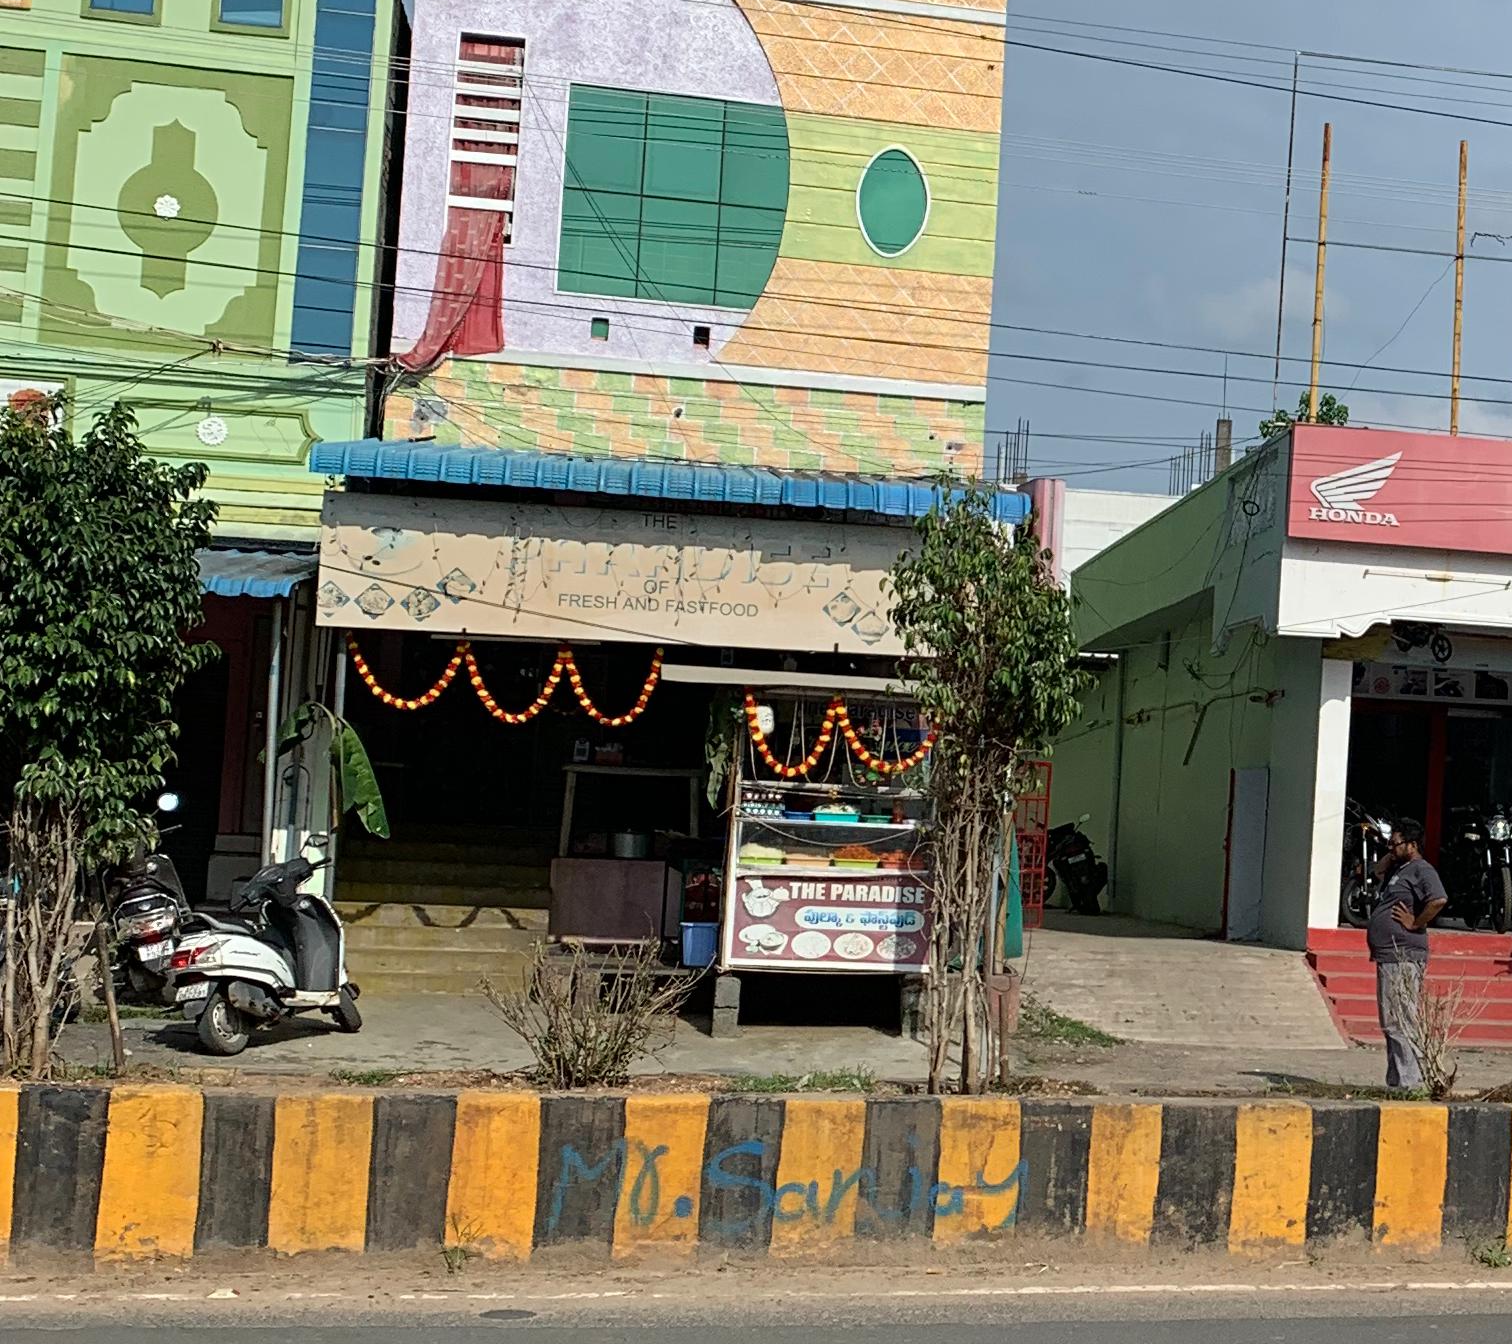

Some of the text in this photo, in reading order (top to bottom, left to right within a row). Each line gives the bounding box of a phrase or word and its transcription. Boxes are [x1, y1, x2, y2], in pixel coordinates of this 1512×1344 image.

[642, 513, 677, 530] THE
[1308, 506, 1401, 527] HONDA
[643, 579, 669, 595] OF
[558, 594, 759, 618] FRESH AND FASTFOOD
[789, 881, 926, 905] THE PARADISE
